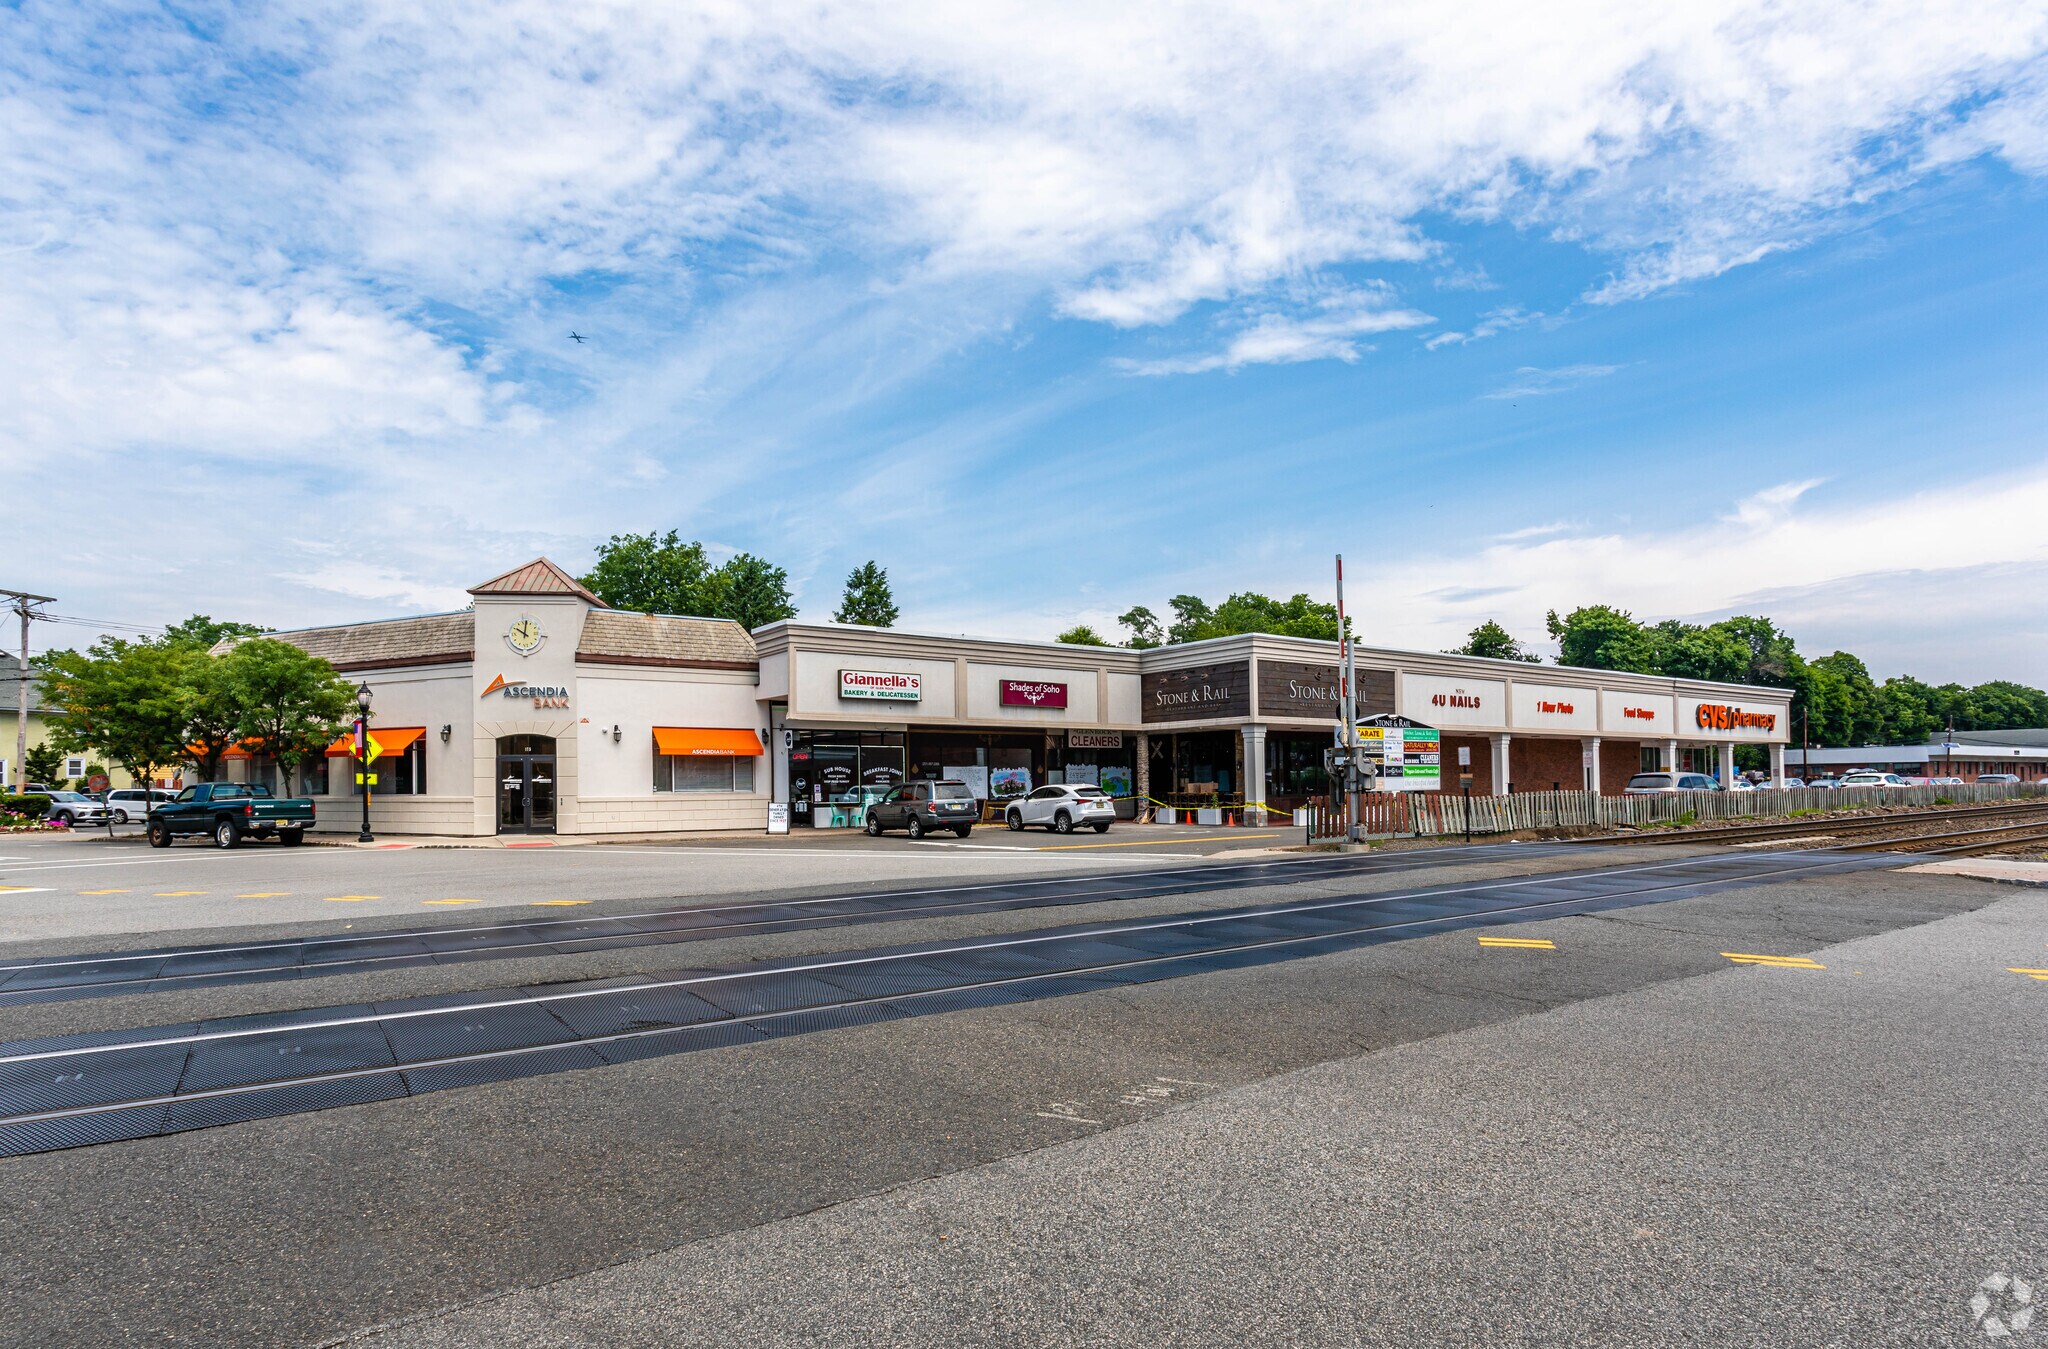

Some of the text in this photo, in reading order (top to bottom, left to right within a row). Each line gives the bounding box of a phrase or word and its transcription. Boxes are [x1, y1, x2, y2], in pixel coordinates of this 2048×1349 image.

[844, 672, 919, 688] Giannella's
[503, 686, 569, 698] ASCENDIA
[1009, 682, 1060, 694] Shades of Soho
[1290, 680, 1326, 700] STONE
[1330, 686, 1338, 700] &
[877, 691, 918, 699] DELICATESSEN
[1156, 684, 1230, 706] STONE & RAIL
[1432, 694, 1480, 708] 4U NAILS
[534, 698, 570, 709] BANK
[1536, 701, 1574, 714] 1 Hour Photo
[1624, 708, 1655, 720] Food Shoppe
[1375, 718, 1392, 727] STONE
[1399, 719, 1411, 728] RAIL
[1071, 736, 1120, 746] CLEANERS
[824, 766, 852, 774] SUB HOUSE
[863, 766, 902, 776] BREAKFAST JOINT
